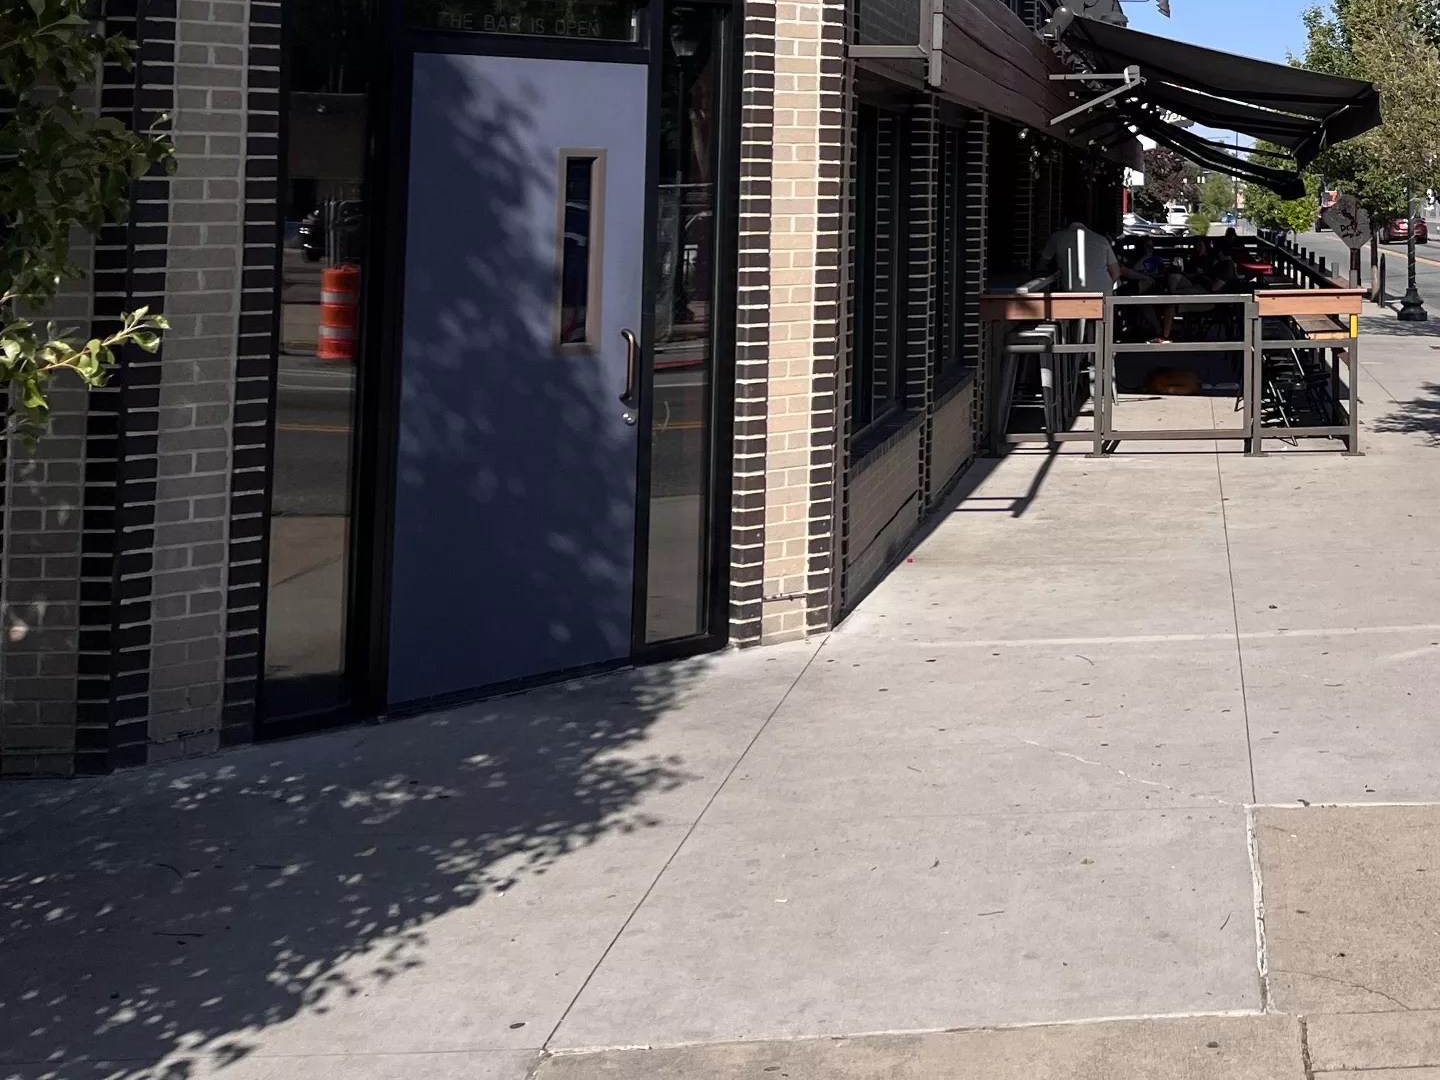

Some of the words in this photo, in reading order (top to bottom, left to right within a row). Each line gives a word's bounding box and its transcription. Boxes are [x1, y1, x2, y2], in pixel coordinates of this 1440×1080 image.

[437, 11, 473, 30] THE
[483, 14, 521, 33] BAR
[531, 18, 545, 35] IS
[554, 19, 600, 37] OPEN
